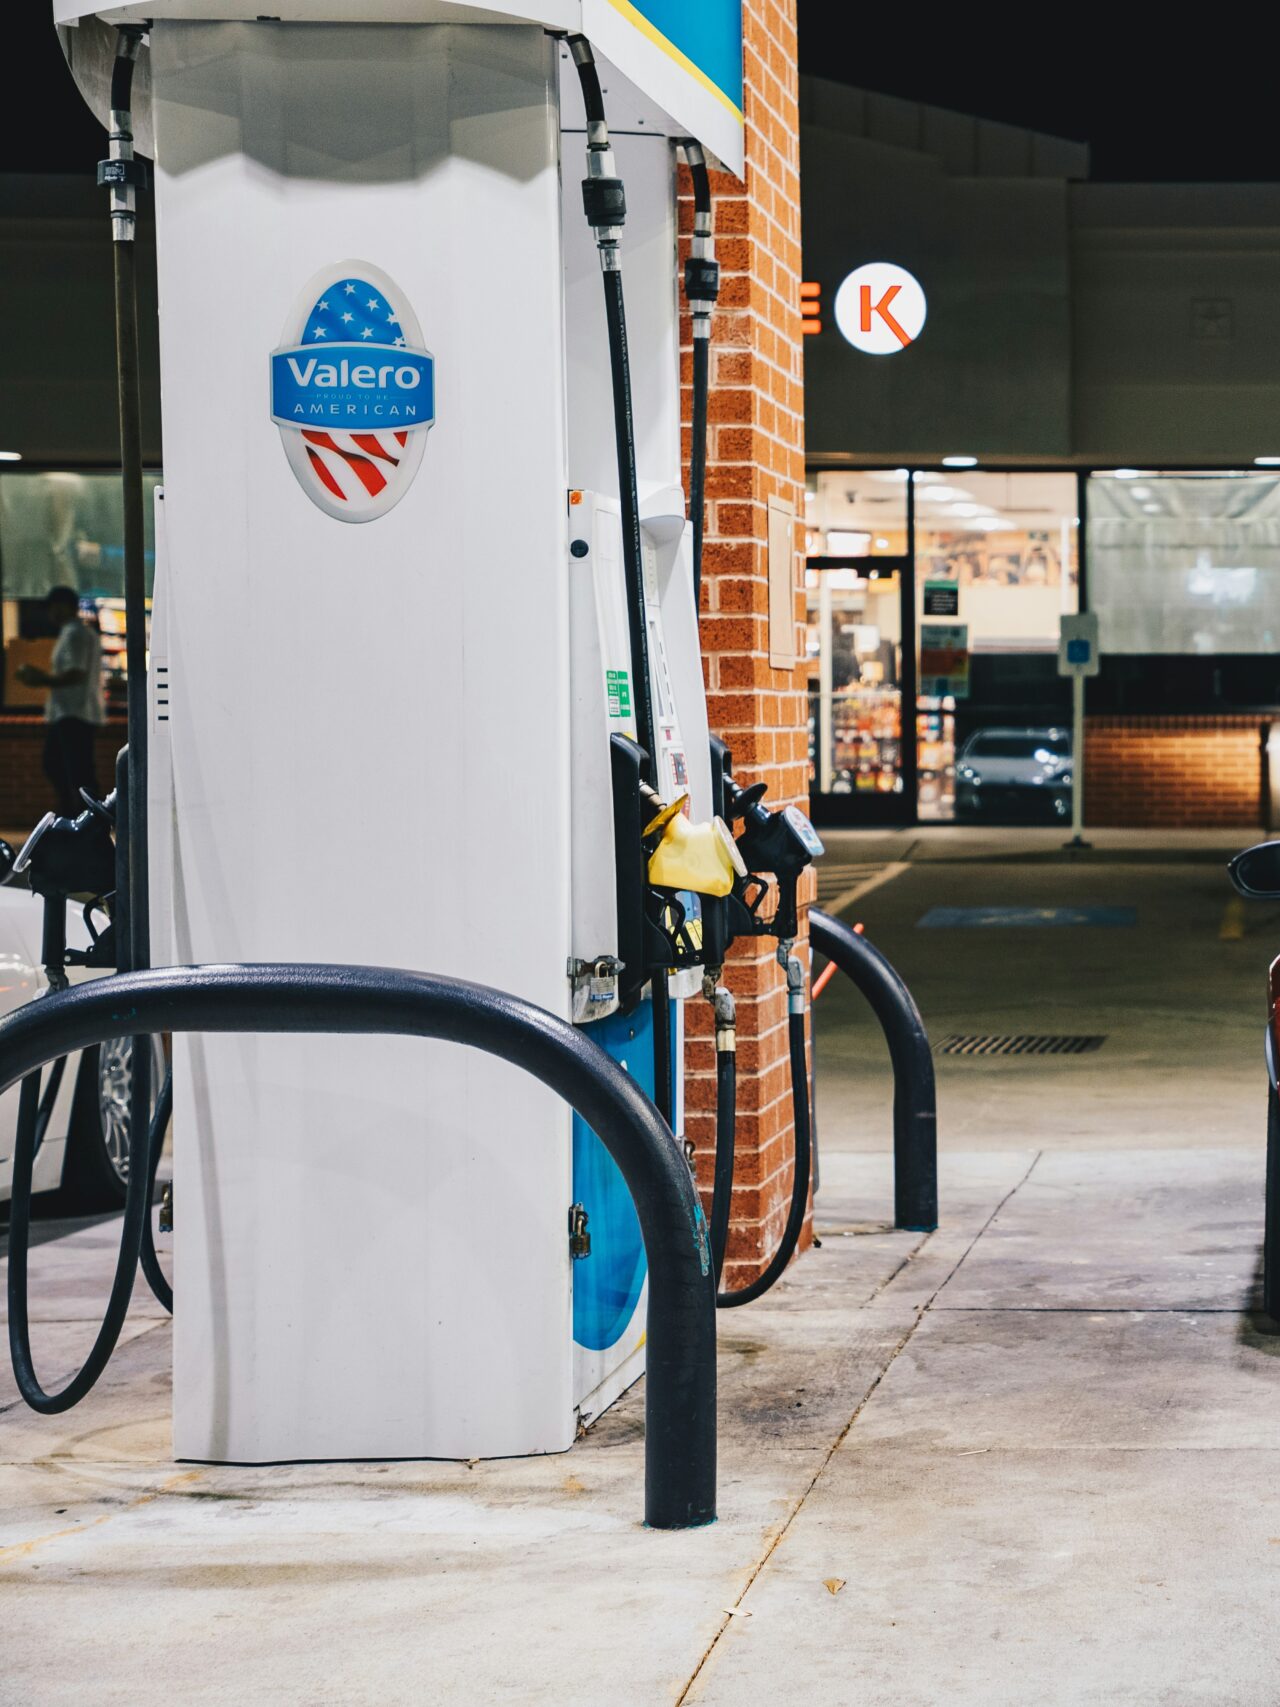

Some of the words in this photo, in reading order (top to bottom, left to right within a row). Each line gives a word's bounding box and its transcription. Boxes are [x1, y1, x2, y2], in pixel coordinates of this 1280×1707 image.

[860, 285, 912, 347] K
[287, 357, 421, 389] Valero
[294, 403, 416, 416] AMERICAN
